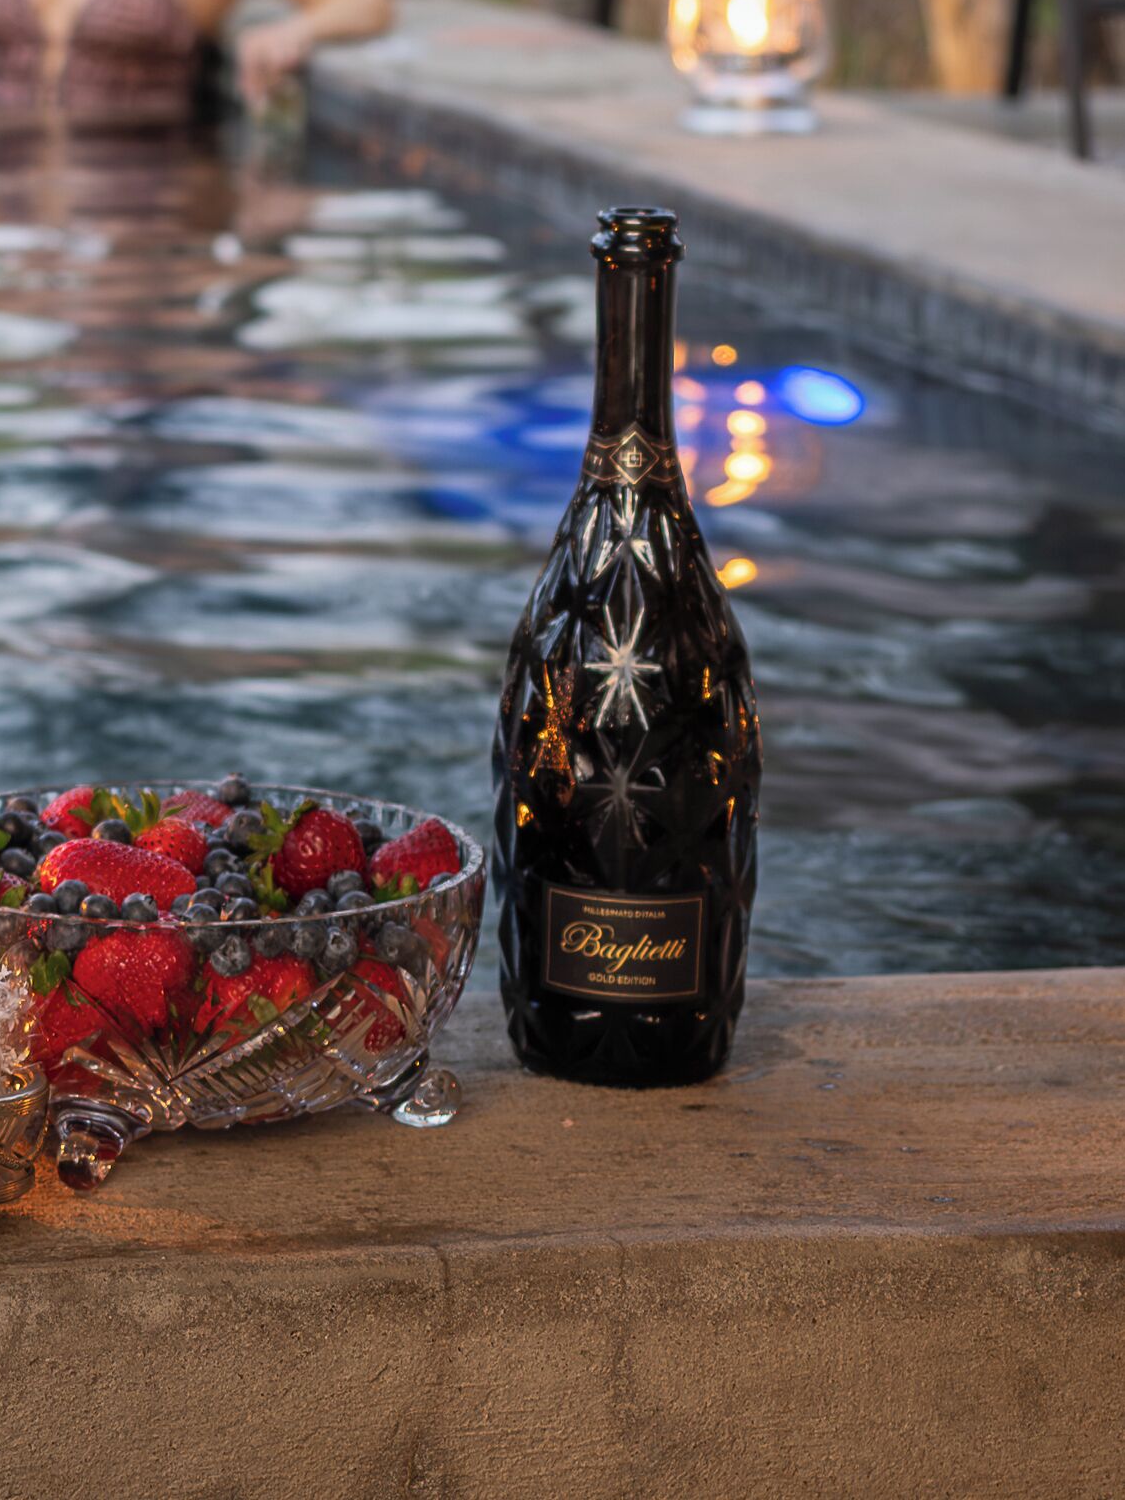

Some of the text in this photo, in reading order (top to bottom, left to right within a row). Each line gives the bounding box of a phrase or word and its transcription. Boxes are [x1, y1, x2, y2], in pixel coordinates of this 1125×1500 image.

[561, 921, 687, 973] Baglietti
[587, 972, 656, 986] GOLD EDITION
